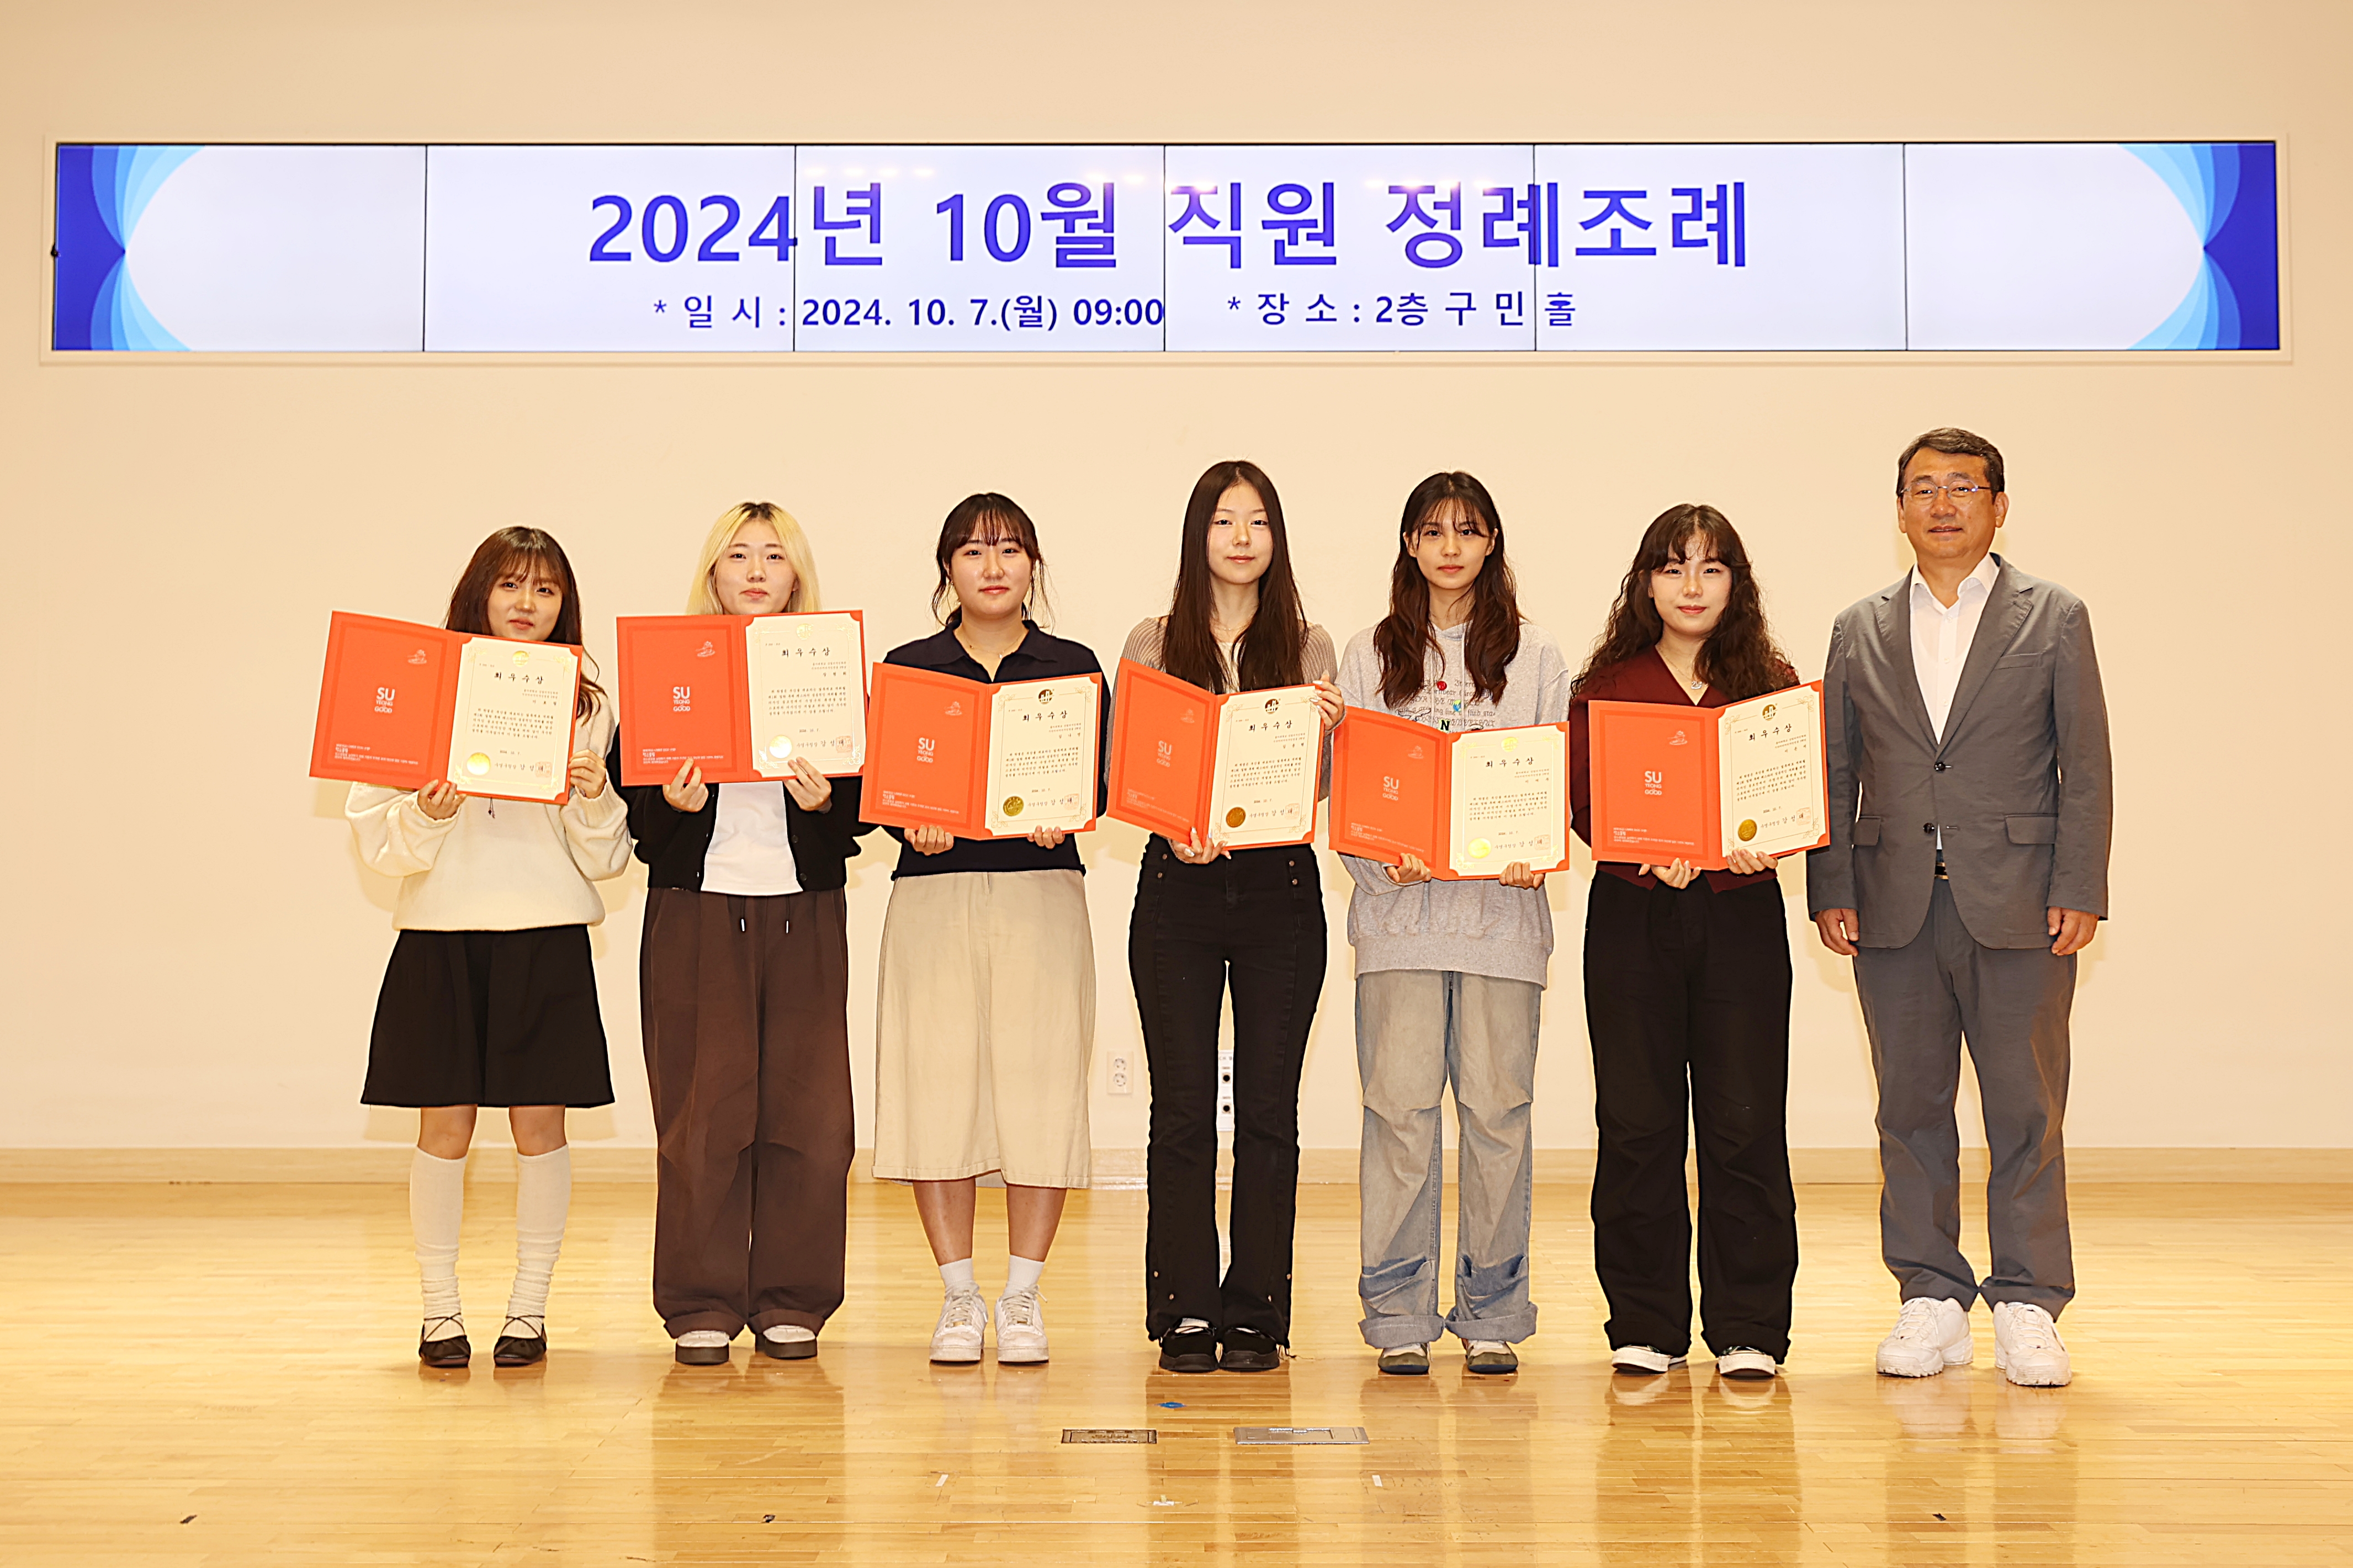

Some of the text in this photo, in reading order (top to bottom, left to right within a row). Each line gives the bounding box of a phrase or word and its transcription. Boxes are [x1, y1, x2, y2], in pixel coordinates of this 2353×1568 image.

[589, 182, 1746, 269] 2024년 10월 직원 정례조례
[803, 299, 891, 326] 2024.
[909, 299, 955, 326] 10.
[1073, 299, 1164, 326] 09:00
[1376, 293, 1428, 326] 2층
[376, 687, 395, 701] SU
[673, 686, 690, 699] SU
[918, 737, 935, 751] SU
[1158, 740, 1172, 756] SU
[1383, 776, 1399, 790] SU
[1644, 770, 1662, 784] SU
